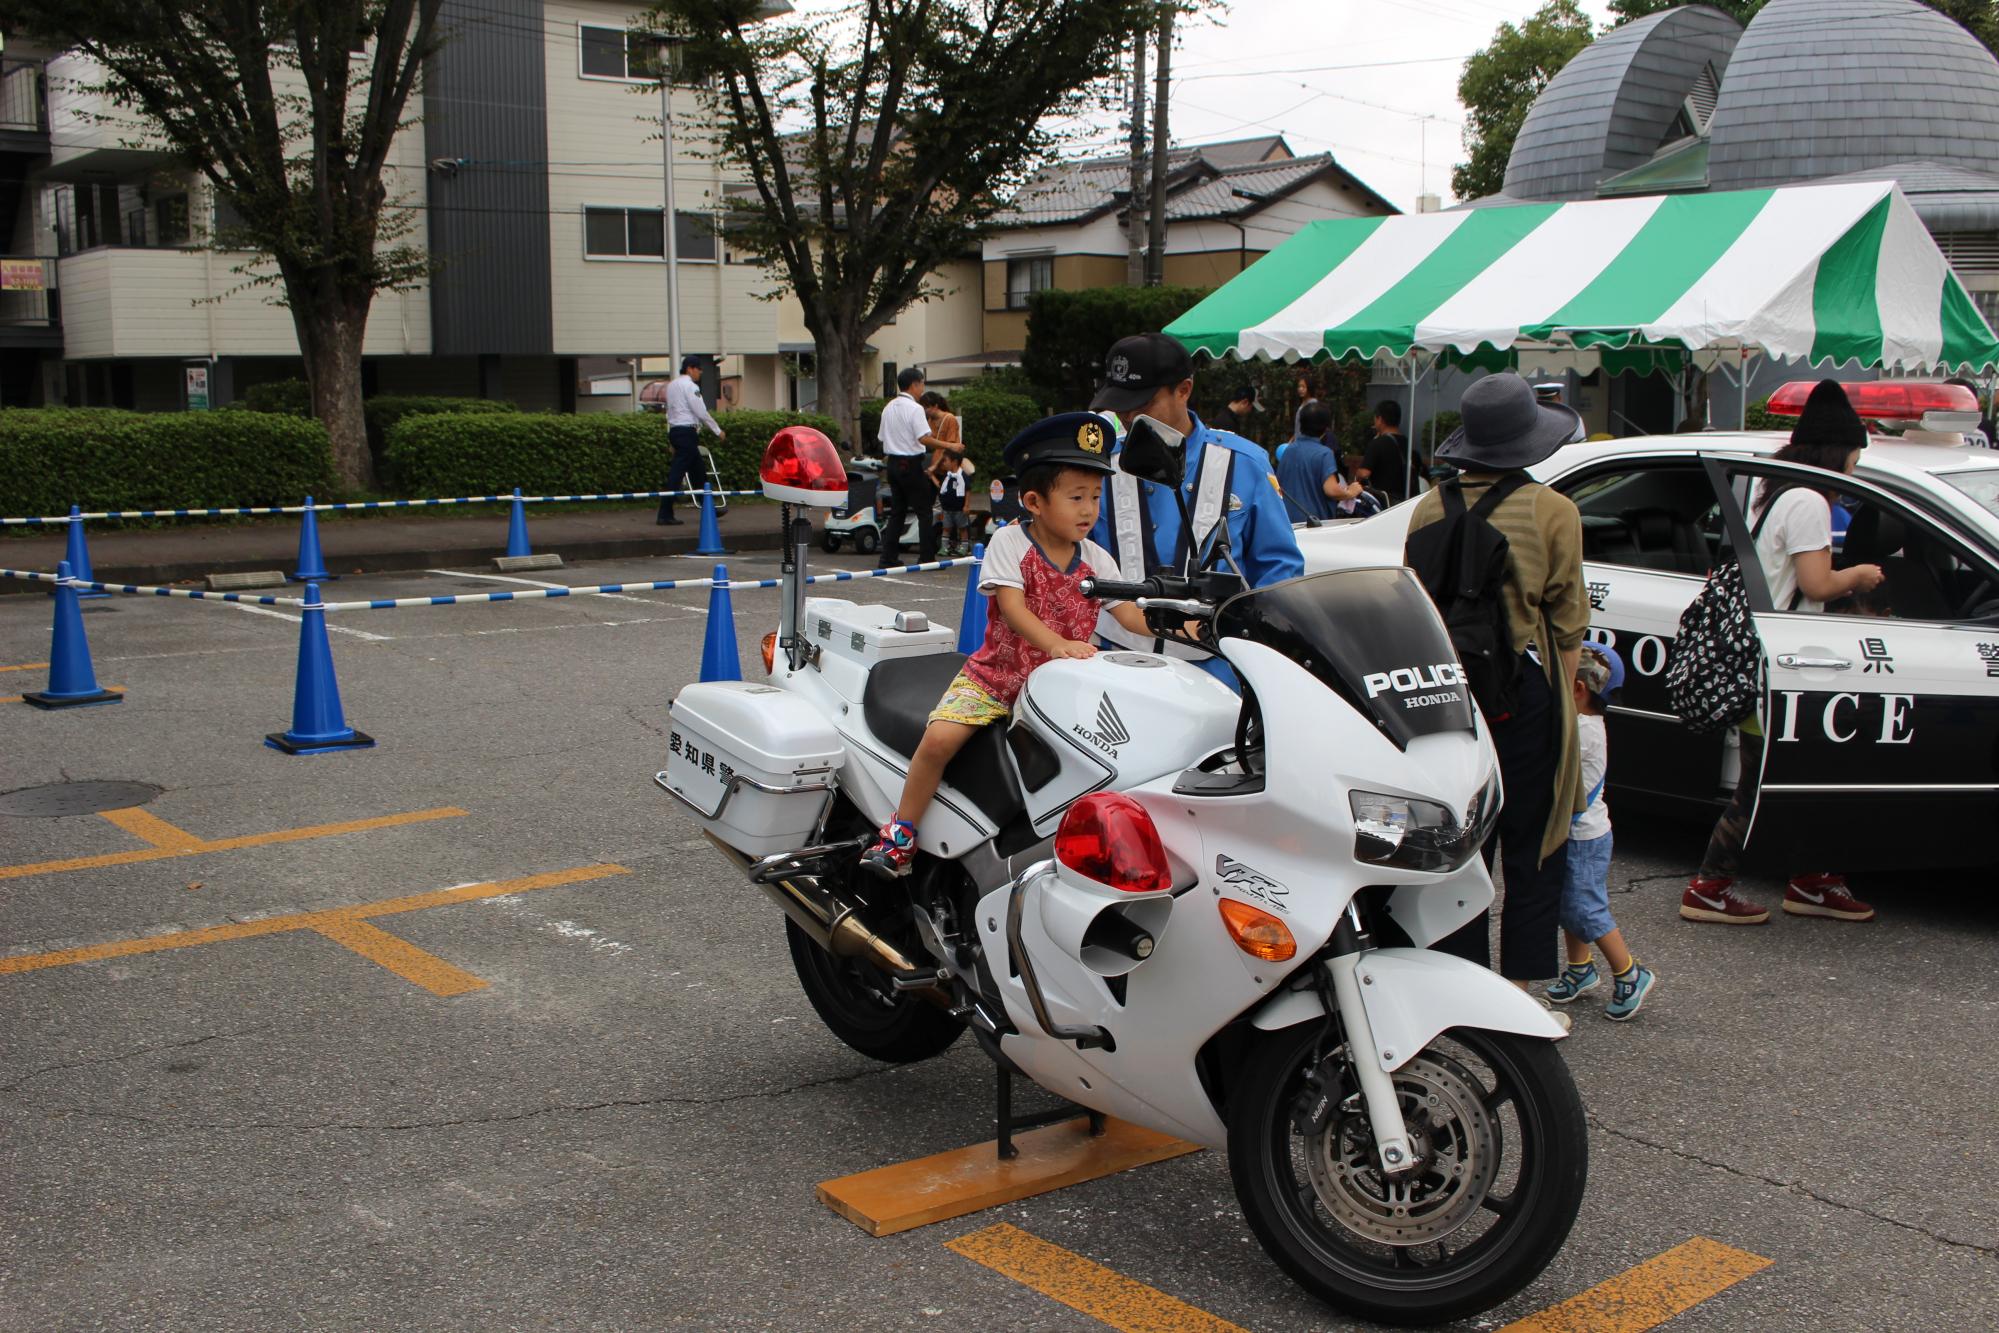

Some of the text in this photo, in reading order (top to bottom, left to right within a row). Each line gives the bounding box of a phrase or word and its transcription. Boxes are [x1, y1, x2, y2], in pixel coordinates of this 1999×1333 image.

[1587, 582, 1611, 612] 愛
[1859, 638, 1895, 674] 県
[1363, 663, 1468, 699] POLICE
[1403, 691, 1462, 709] HONDA
[669, 731, 735, 787] 愛知県警
[1073, 723, 1119, 760] HONDA
[1216, 853, 1290, 909] VFR
